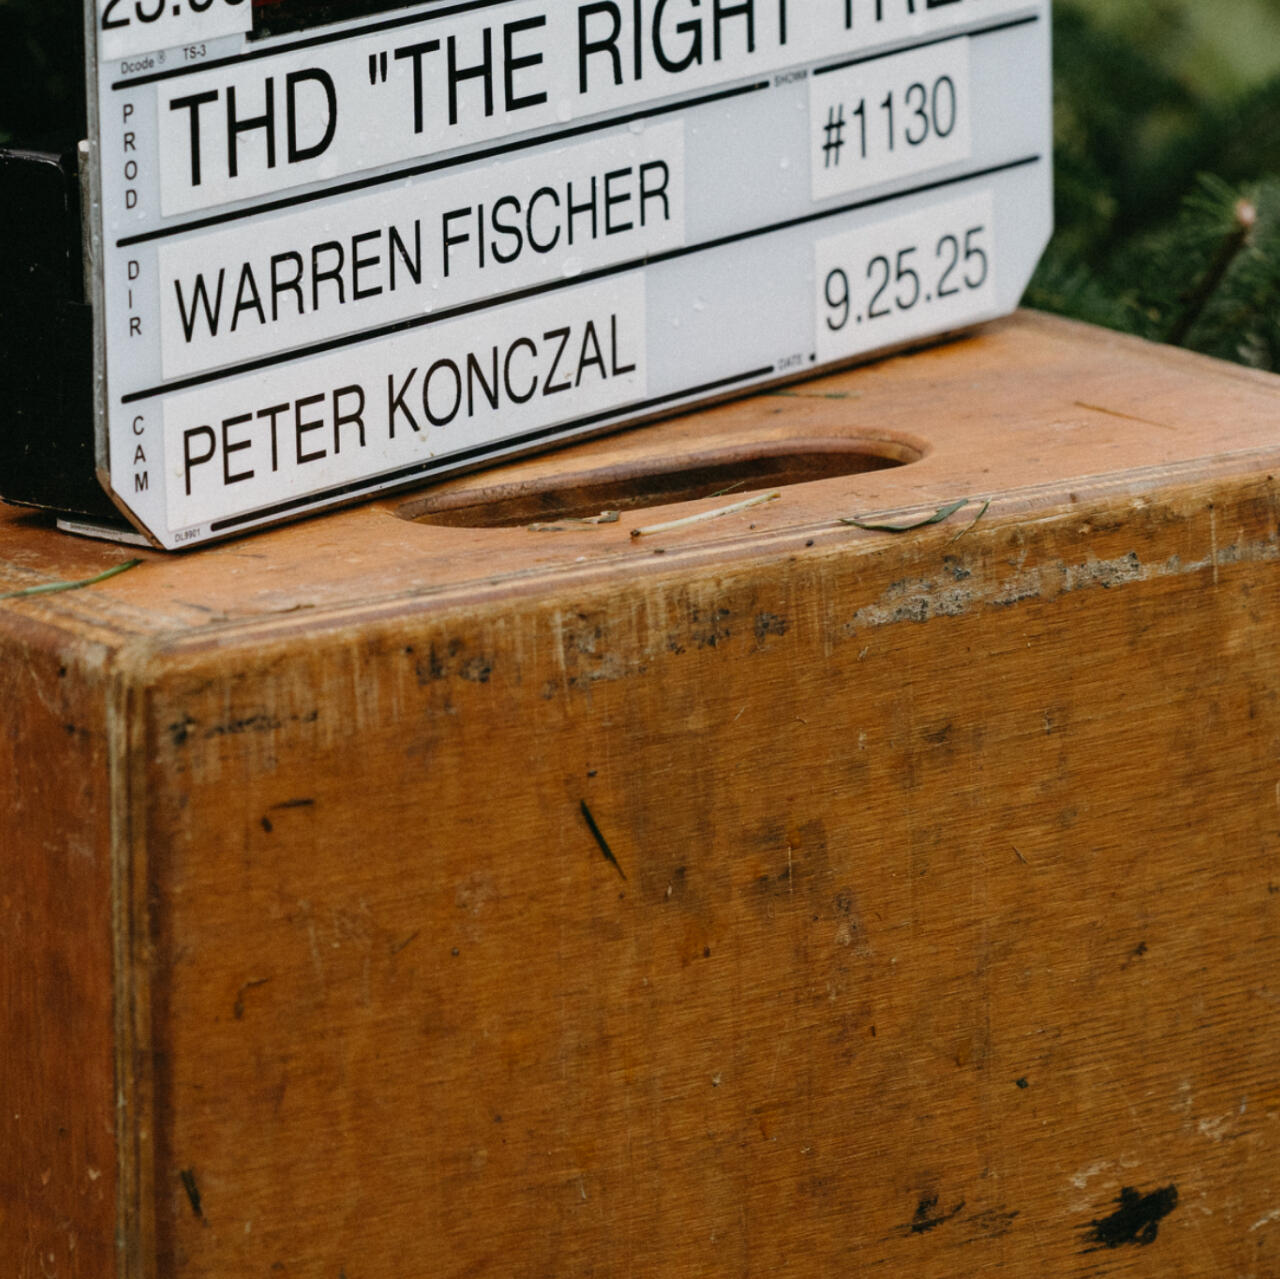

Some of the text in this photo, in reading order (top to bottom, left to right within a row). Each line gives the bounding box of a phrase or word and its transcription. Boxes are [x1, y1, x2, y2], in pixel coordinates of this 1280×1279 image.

[169, 67, 337, 186] THD
[369, 14, 548, 134] "THE
[183, 44, 207, 60] TS-3
[123, 103, 139, 210] PROD
[823, 75, 956, 168] #1130
[128, 260, 142, 337] DIR
[174, 159, 670, 343] WARREN FISCHER
[825, 225, 988, 331] 9.25.25
[132, 415, 149, 493] CAM
[183, 313, 636, 496] PETER KONCZAL
